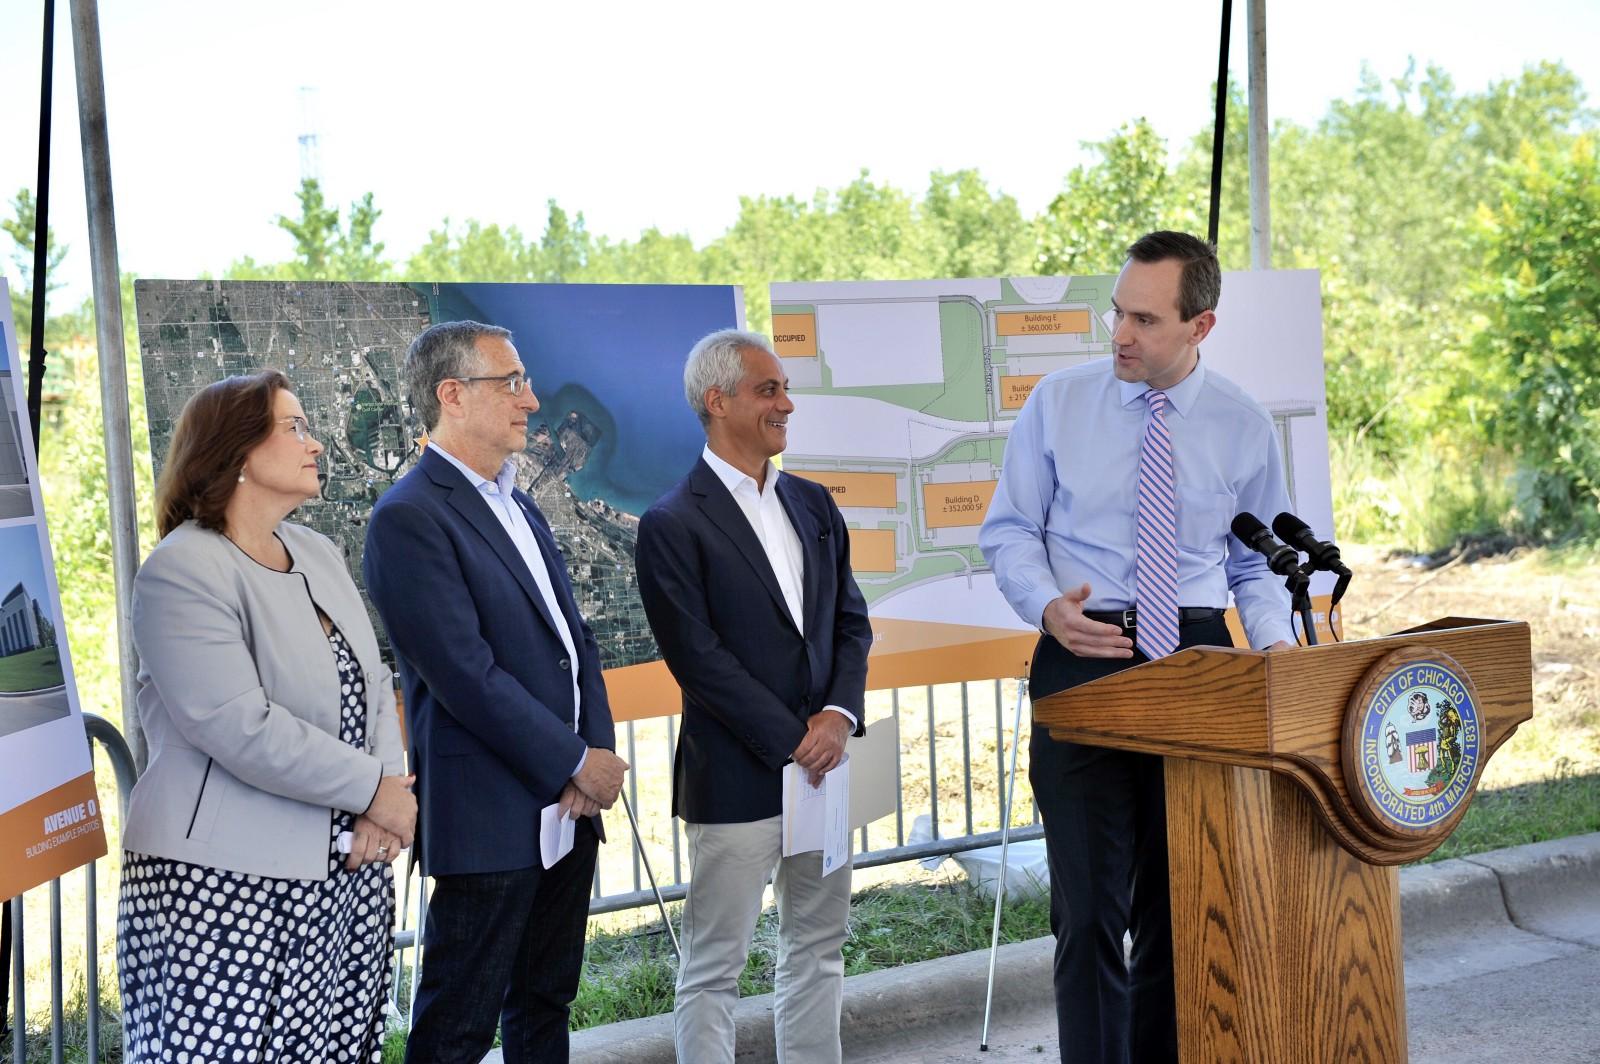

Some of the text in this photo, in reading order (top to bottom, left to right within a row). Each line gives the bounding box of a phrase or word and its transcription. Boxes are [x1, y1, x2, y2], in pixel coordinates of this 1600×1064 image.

[1024, 313, 1057, 323] Building E
[1027, 324, 1053, 332] 360,000
[1054, 323, 1062, 331] SF
[773, 334, 806, 343] OCCUPIED
[1014, 393, 1029, 401] 215
[826, 485, 846, 494] UPIED
[945, 495, 980, 505] Building D
[949, 504, 975, 513] 352,000
[975, 503, 983, 511] SF
[1374, 669, 1465, 716] CITY OF CHICAGO
[1365, 718, 1476, 821] INCORPORATED 4th MARCH 1837
[44, 803, 87, 835] AVENUE
[25, 819, 100, 859] BUILDING EXAMPLE PHOTOS
